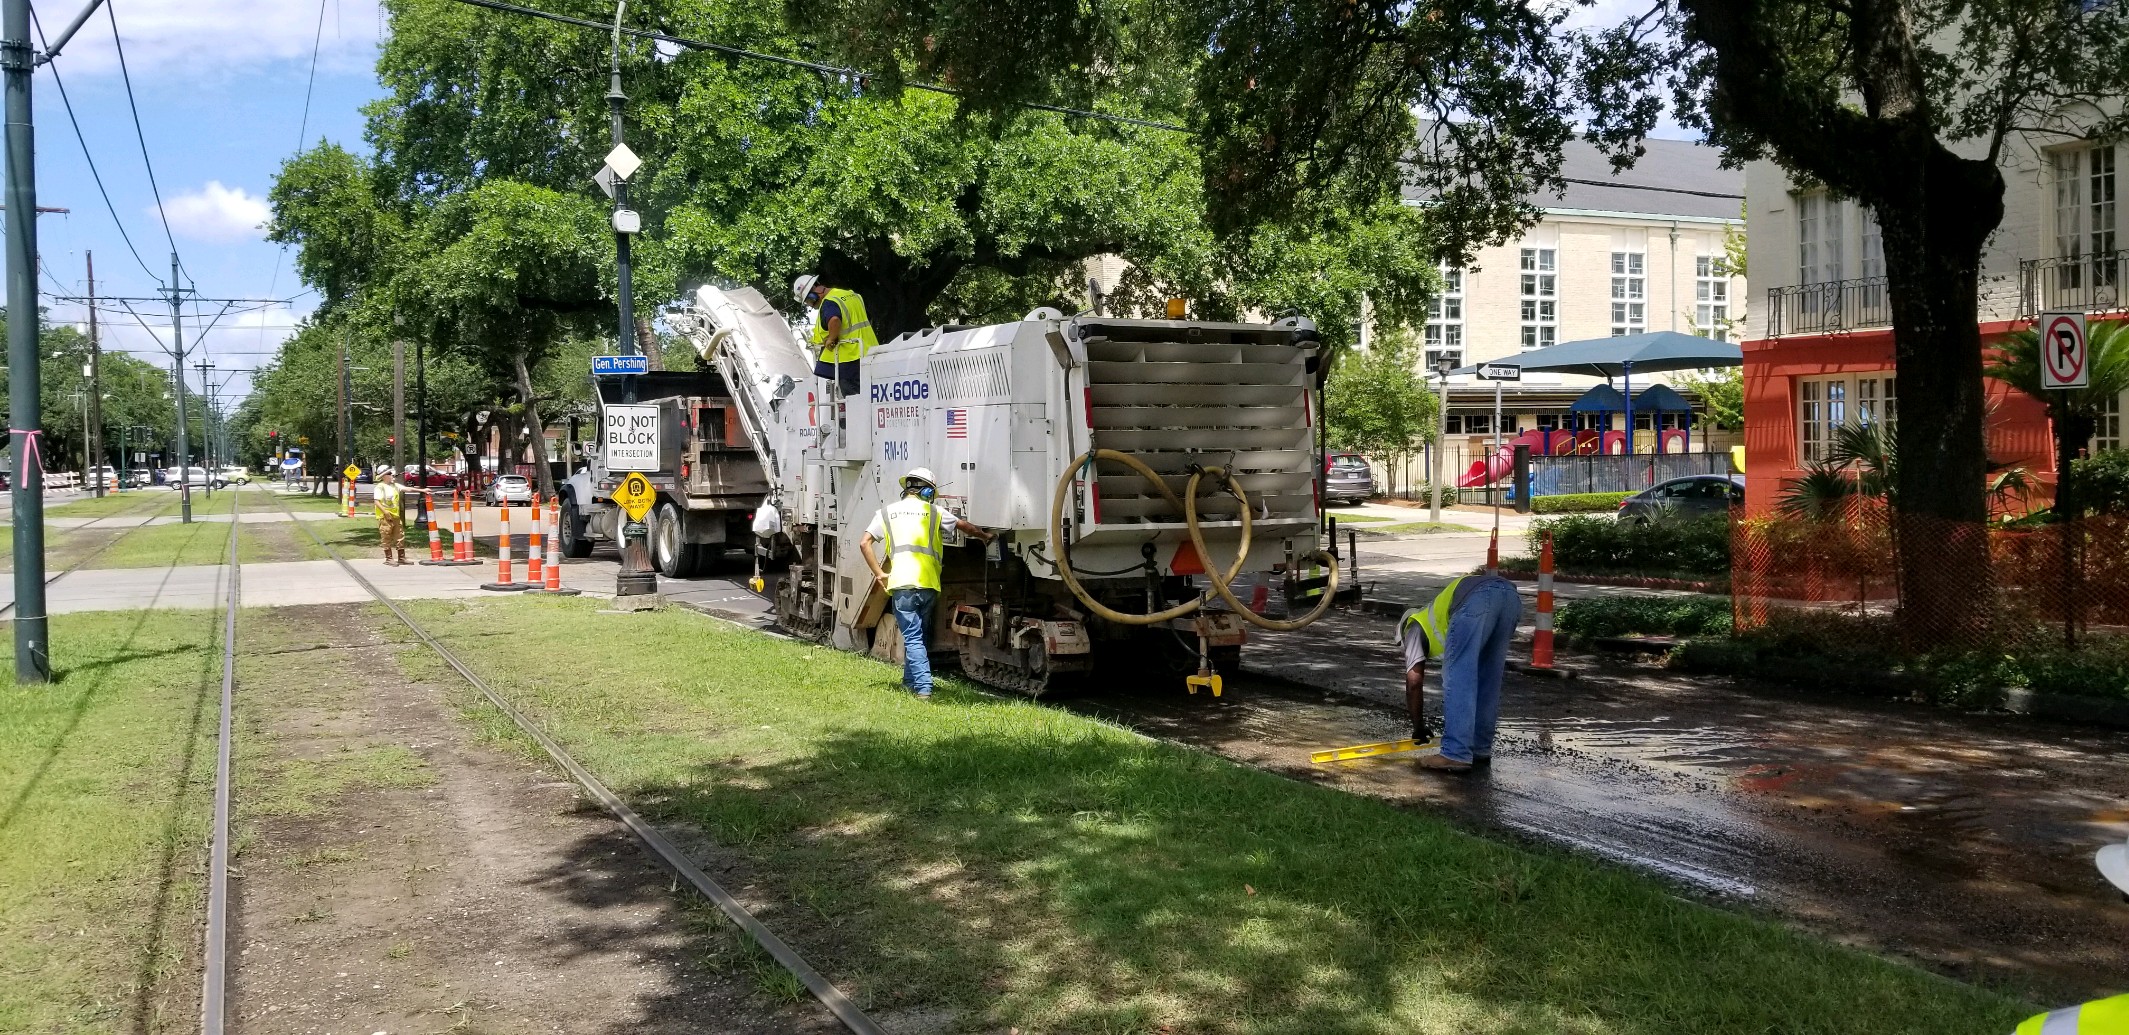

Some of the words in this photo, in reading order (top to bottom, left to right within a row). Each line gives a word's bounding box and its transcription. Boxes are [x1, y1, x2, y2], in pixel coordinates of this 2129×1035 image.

[595, 358, 611, 370] Gen.
[613, 356, 646, 372] Pershing
[871, 380, 929, 404] RX-600e
[886, 406, 919, 419] BARRIERE
[608, 415, 626, 428] DO
[631, 415, 657, 428] NOT
[609, 432, 655, 445] BLOCK
[611, 449, 653, 458] INTERSECTION
[884, 441, 909, 461] RM-18
